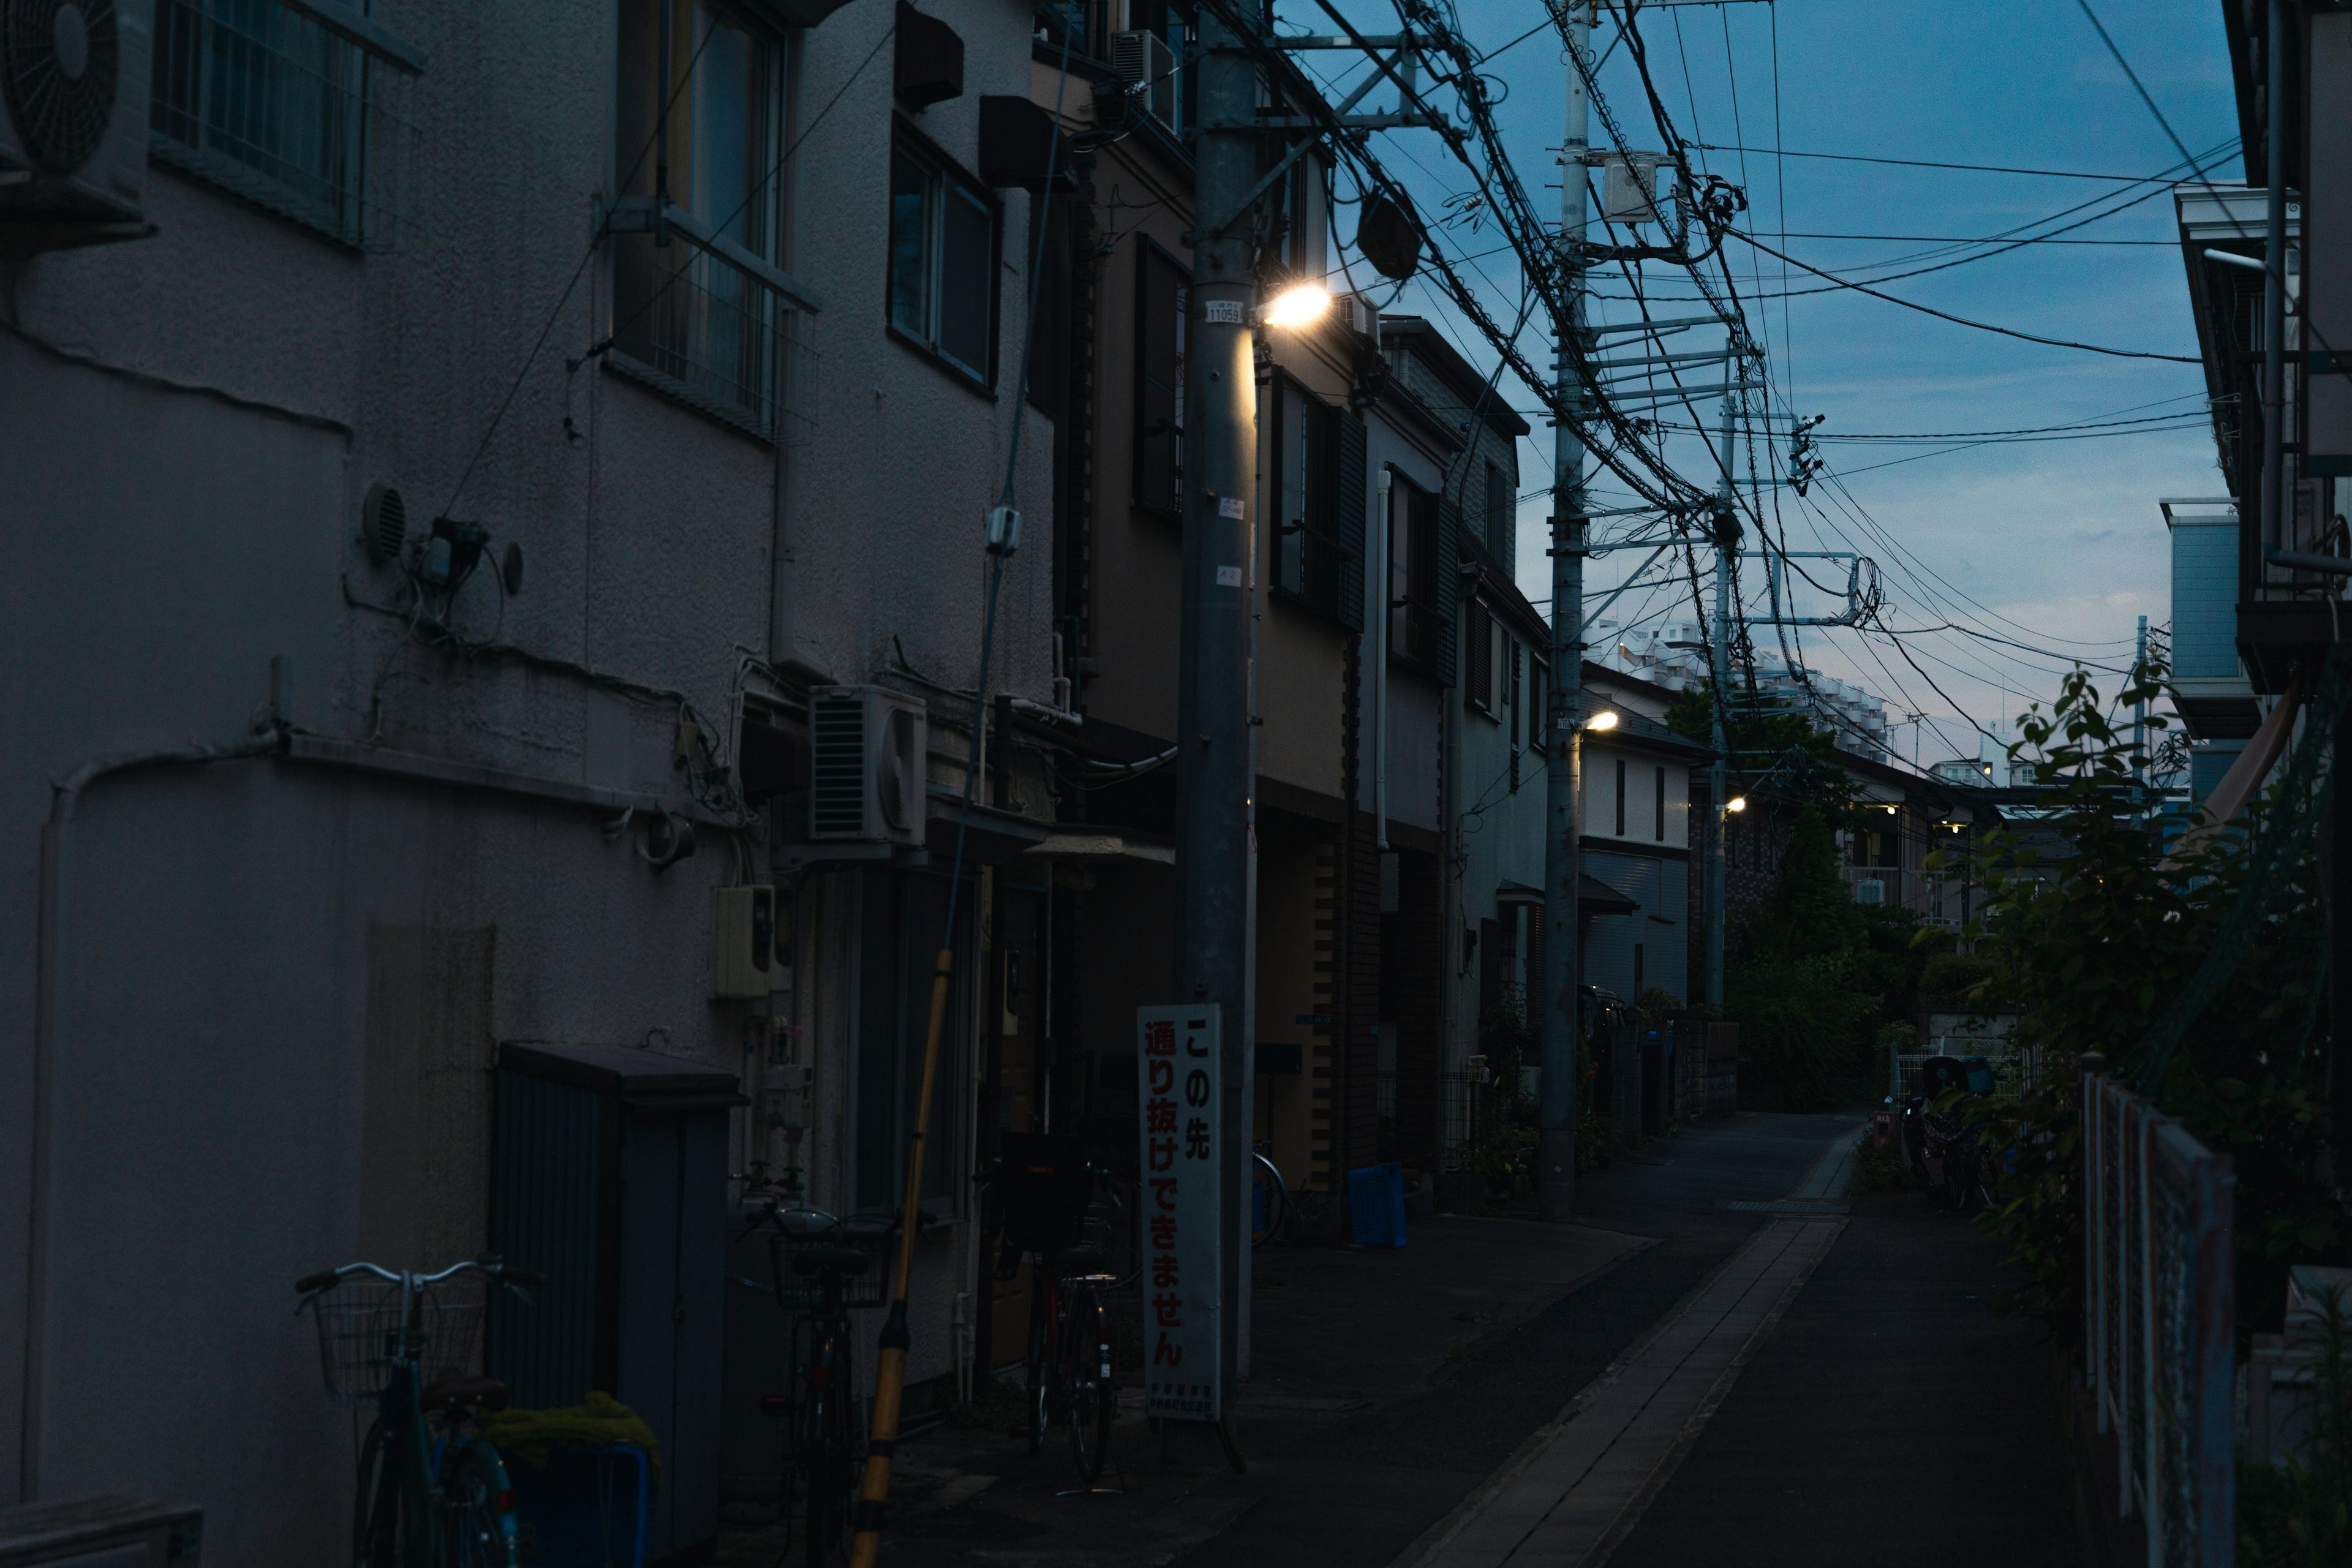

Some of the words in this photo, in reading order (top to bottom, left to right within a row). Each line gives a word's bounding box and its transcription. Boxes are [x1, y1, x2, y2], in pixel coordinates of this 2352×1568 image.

[1210, 309, 1238, 322] 11059
[1185, 1019, 1210, 1160] この先
[1144, 1020, 1183, 1367] 通り抜けできません
